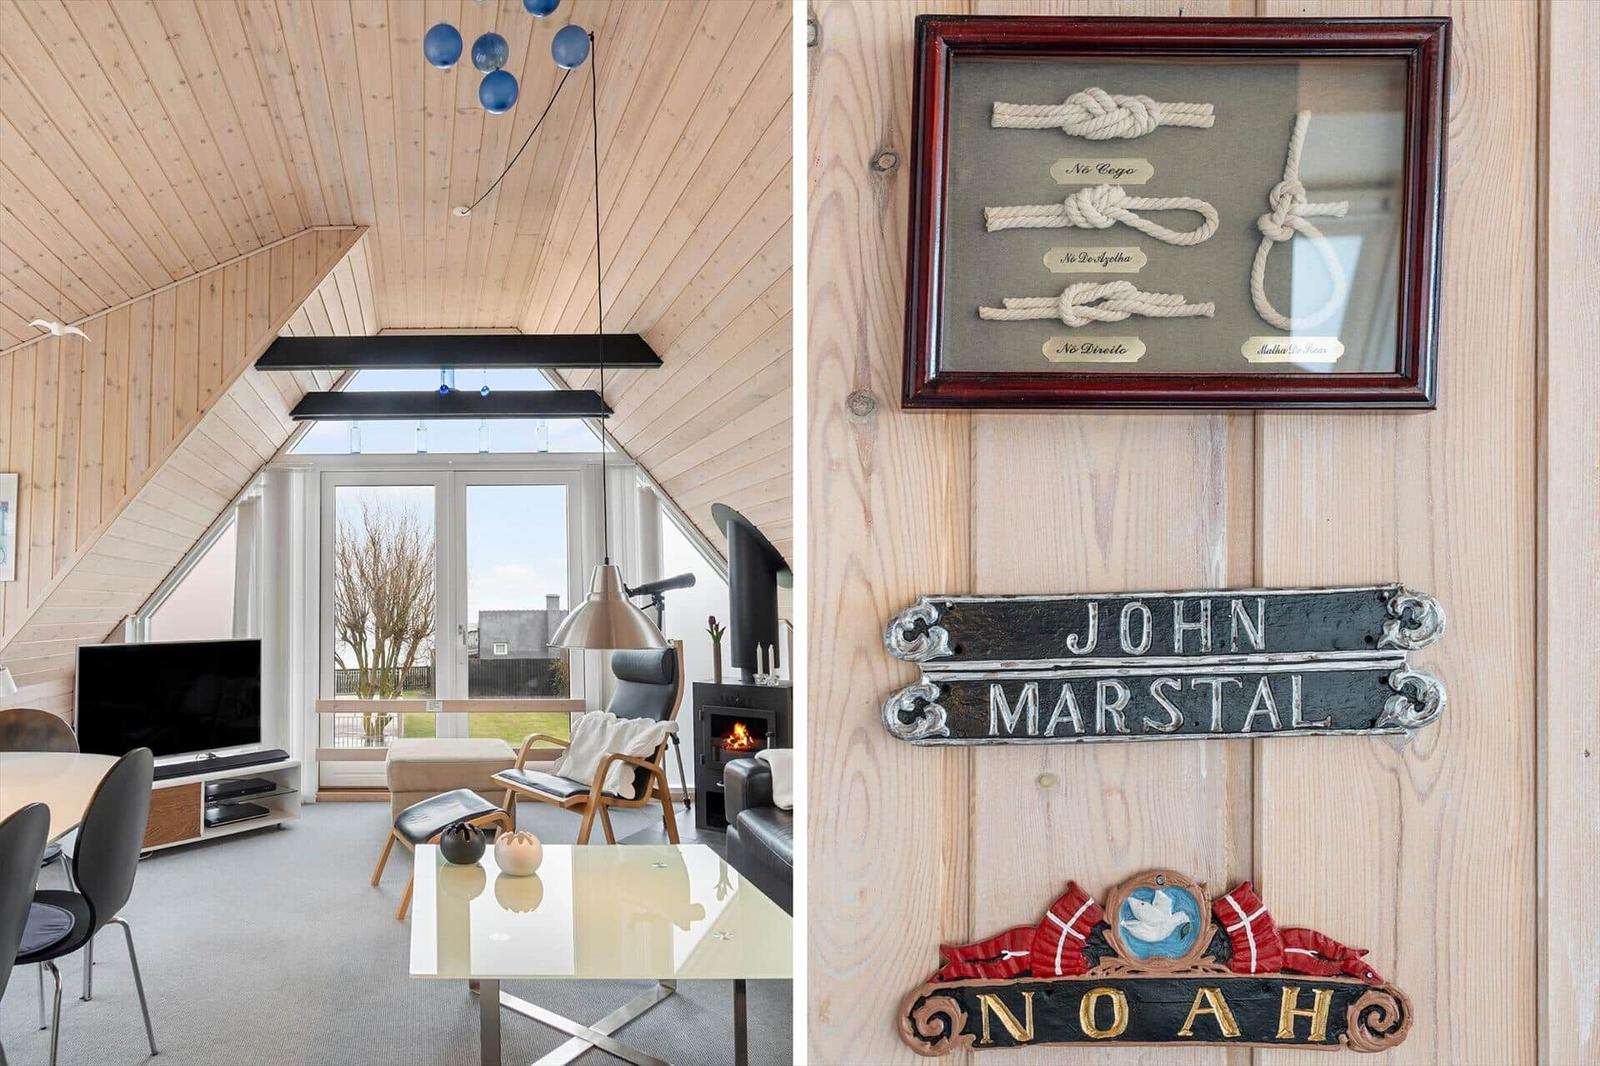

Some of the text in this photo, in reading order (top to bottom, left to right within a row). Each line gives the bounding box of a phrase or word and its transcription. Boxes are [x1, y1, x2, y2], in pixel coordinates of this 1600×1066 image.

[1095, 162, 1137, 180] Cego
[1078, 251, 1094, 264] De
[1093, 251, 1133, 267] Azelha
[1080, 342, 1129, 355] Direito
[1256, 344, 1289, 355] Malha
[1065, 596, 1267, 656] JOHN
[988, 674, 1333, 738] MARSTAL
[975, 985, 1336, 1044] NOAH
